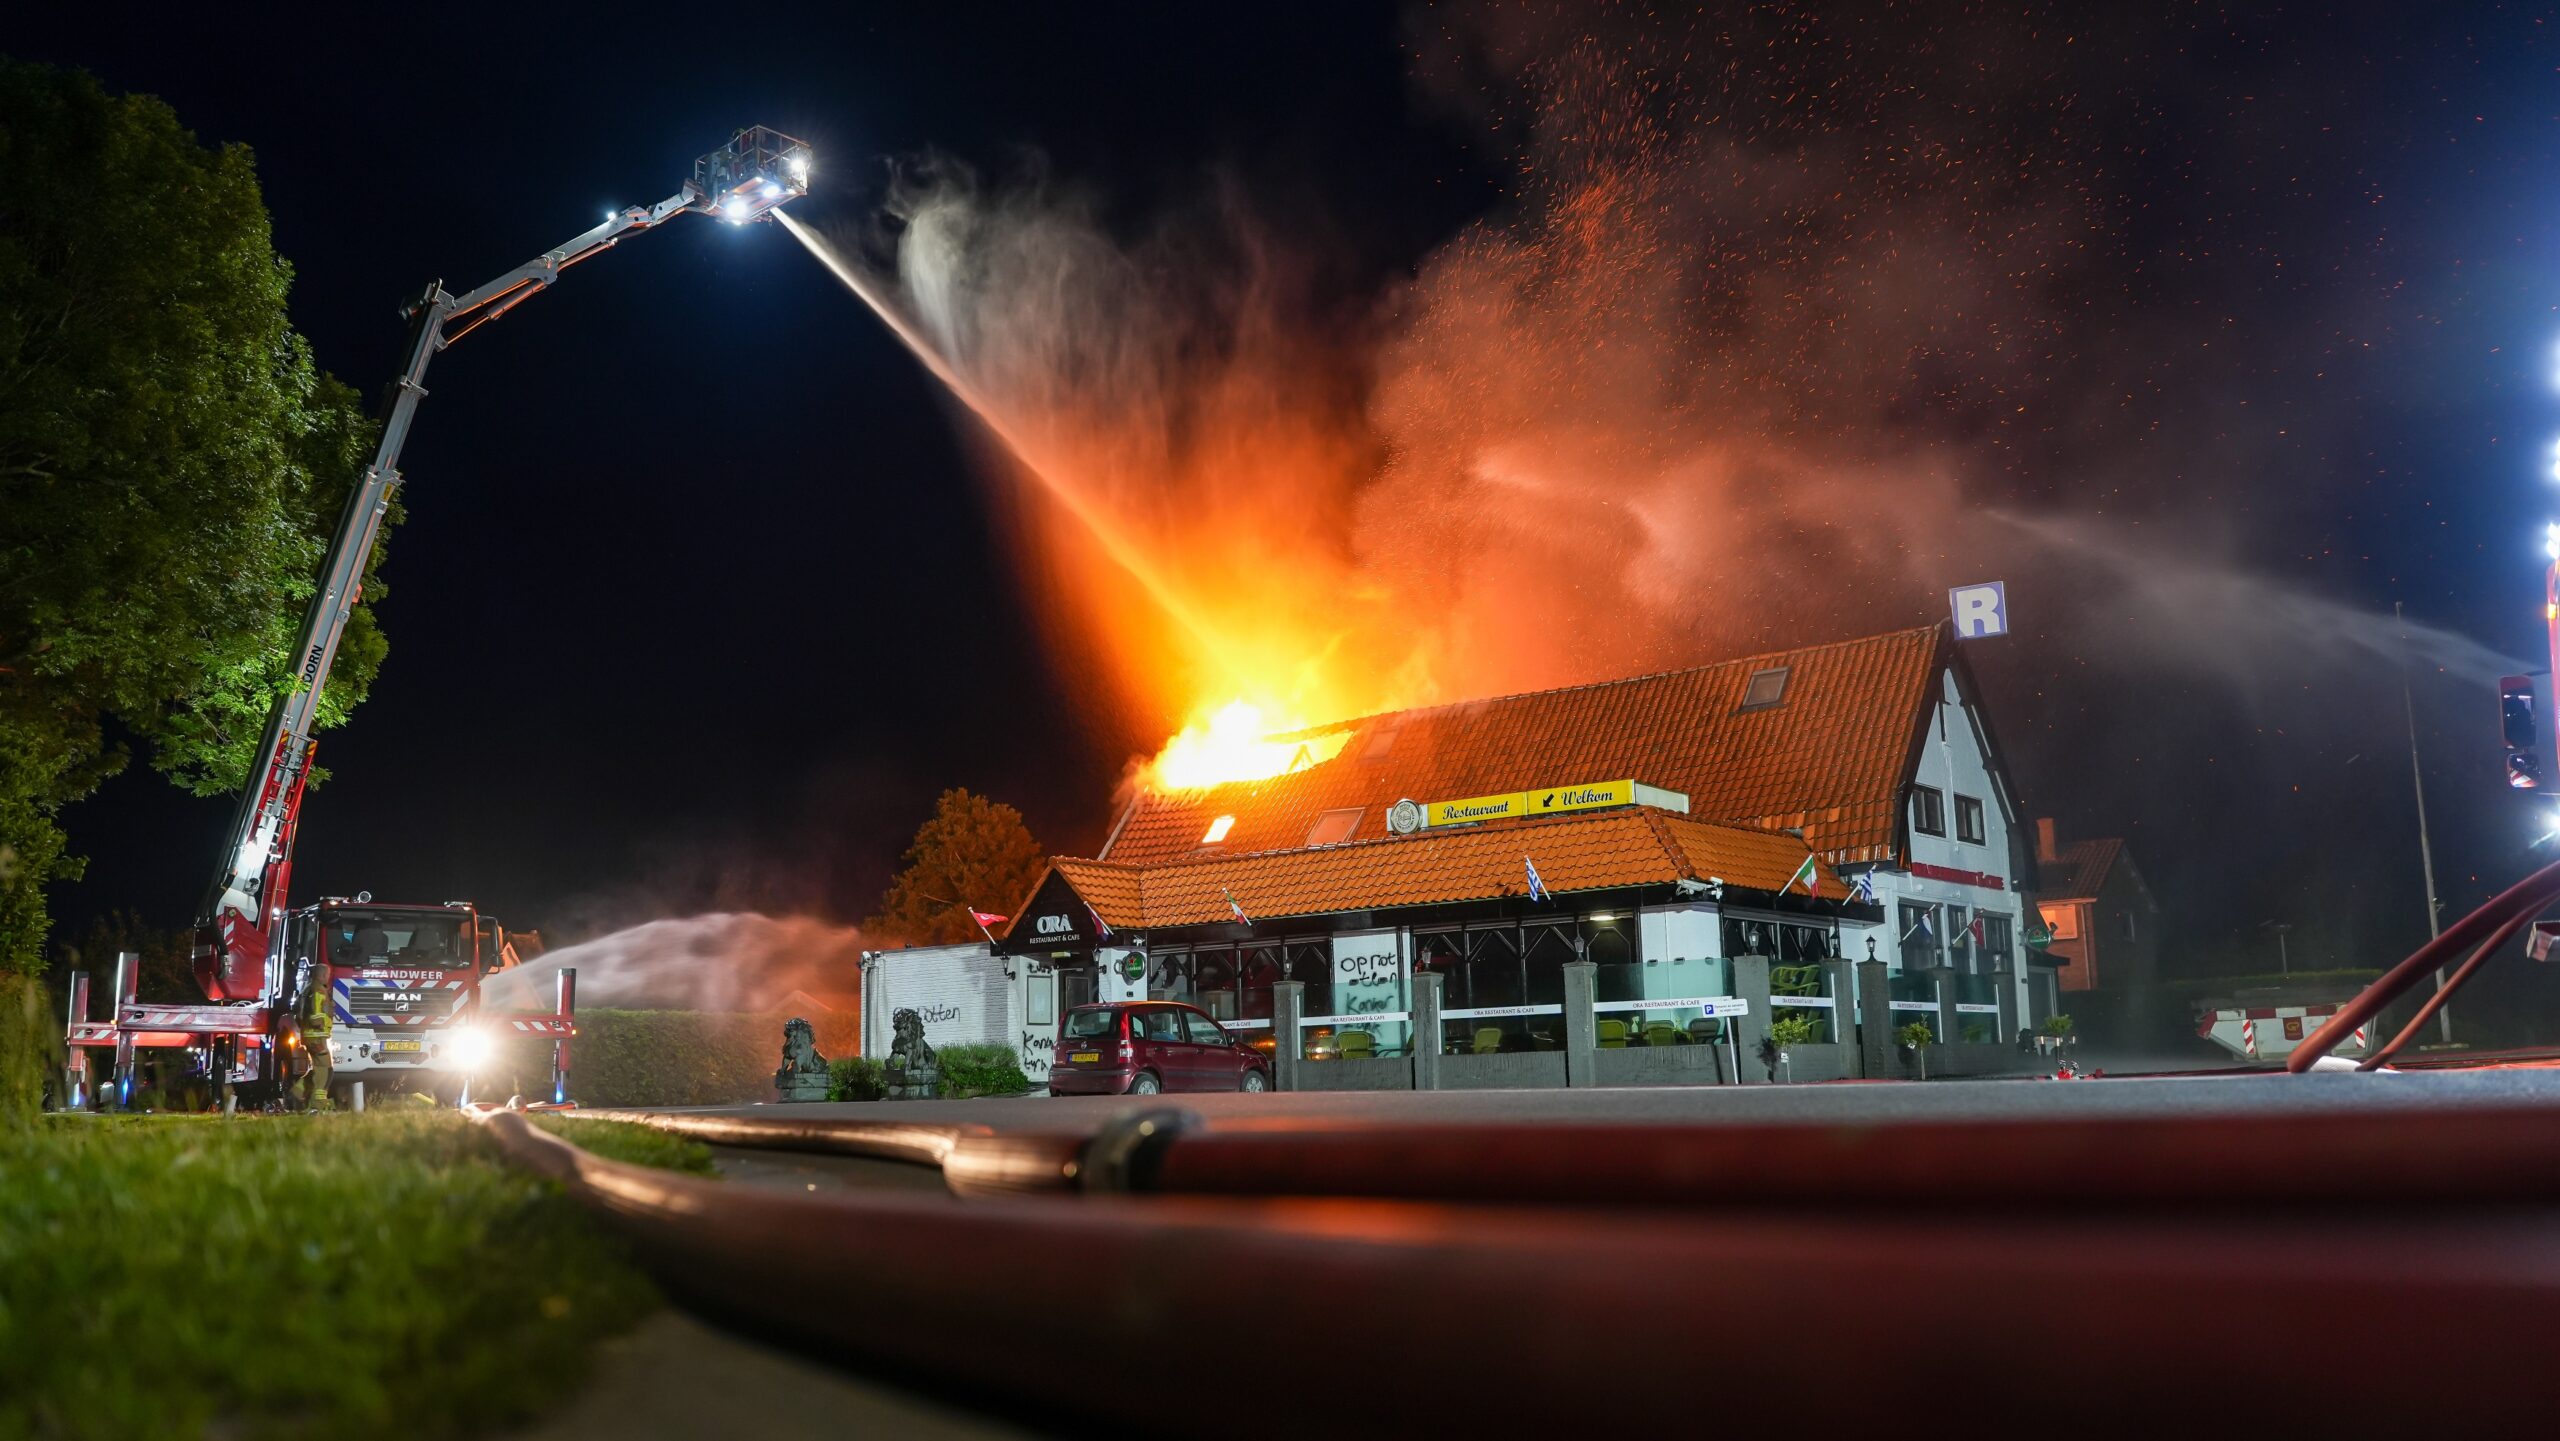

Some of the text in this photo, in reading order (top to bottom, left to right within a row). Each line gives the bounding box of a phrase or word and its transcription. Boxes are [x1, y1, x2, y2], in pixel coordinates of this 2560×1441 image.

[1956, 587, 2001, 638] R
[1442, 788, 1614, 820] Restaurant Welkom
[1036, 913, 1073, 934] ORA
[1029, 935, 1062, 944] RESTAURANT
[1062, 934, 1067, 942] &
[362, 969, 444, 980] BRANDWEER
[383, 992, 422, 1001] MAN
[1632, 1001, 1644, 1009] ORA
[1644, 1000, 1680, 1008] RESTAURANT
